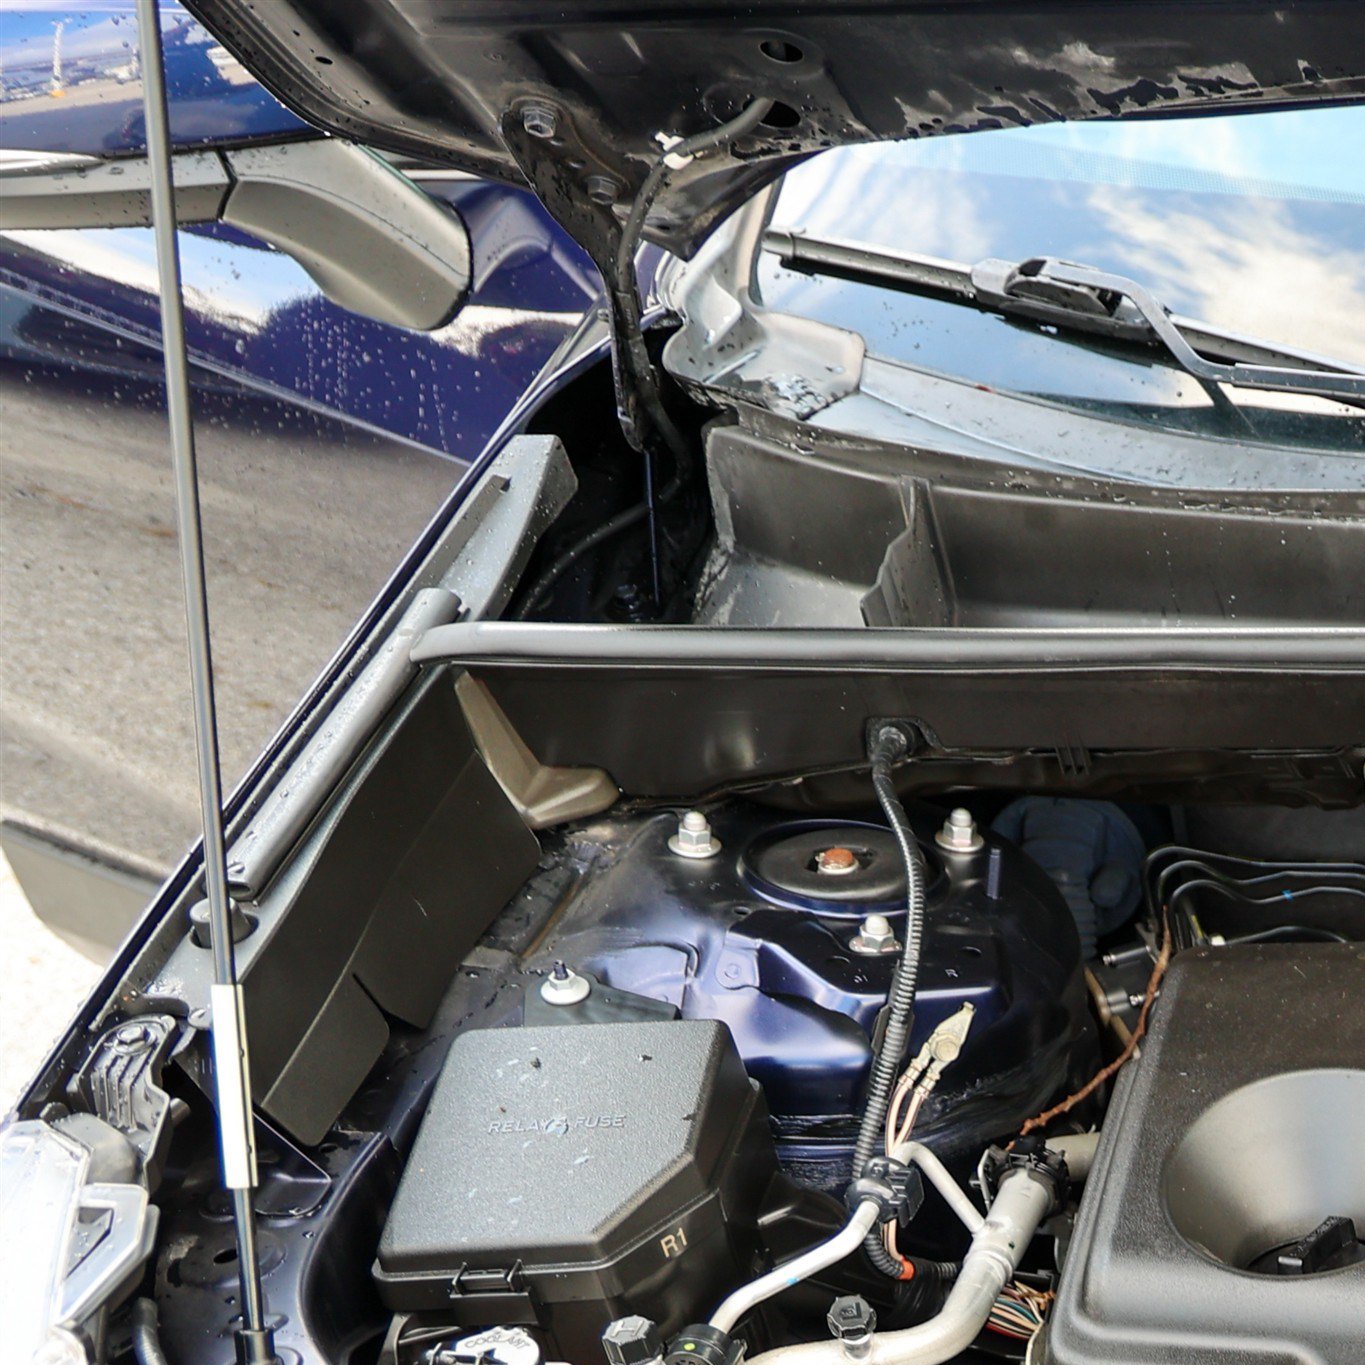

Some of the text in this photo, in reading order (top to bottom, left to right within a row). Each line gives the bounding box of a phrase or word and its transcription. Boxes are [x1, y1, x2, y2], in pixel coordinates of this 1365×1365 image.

[574, 1115, 627, 1128] FUSE
[660, 1227, 688, 1258] R1
[464, 1330, 531, 1350] COOLANT
